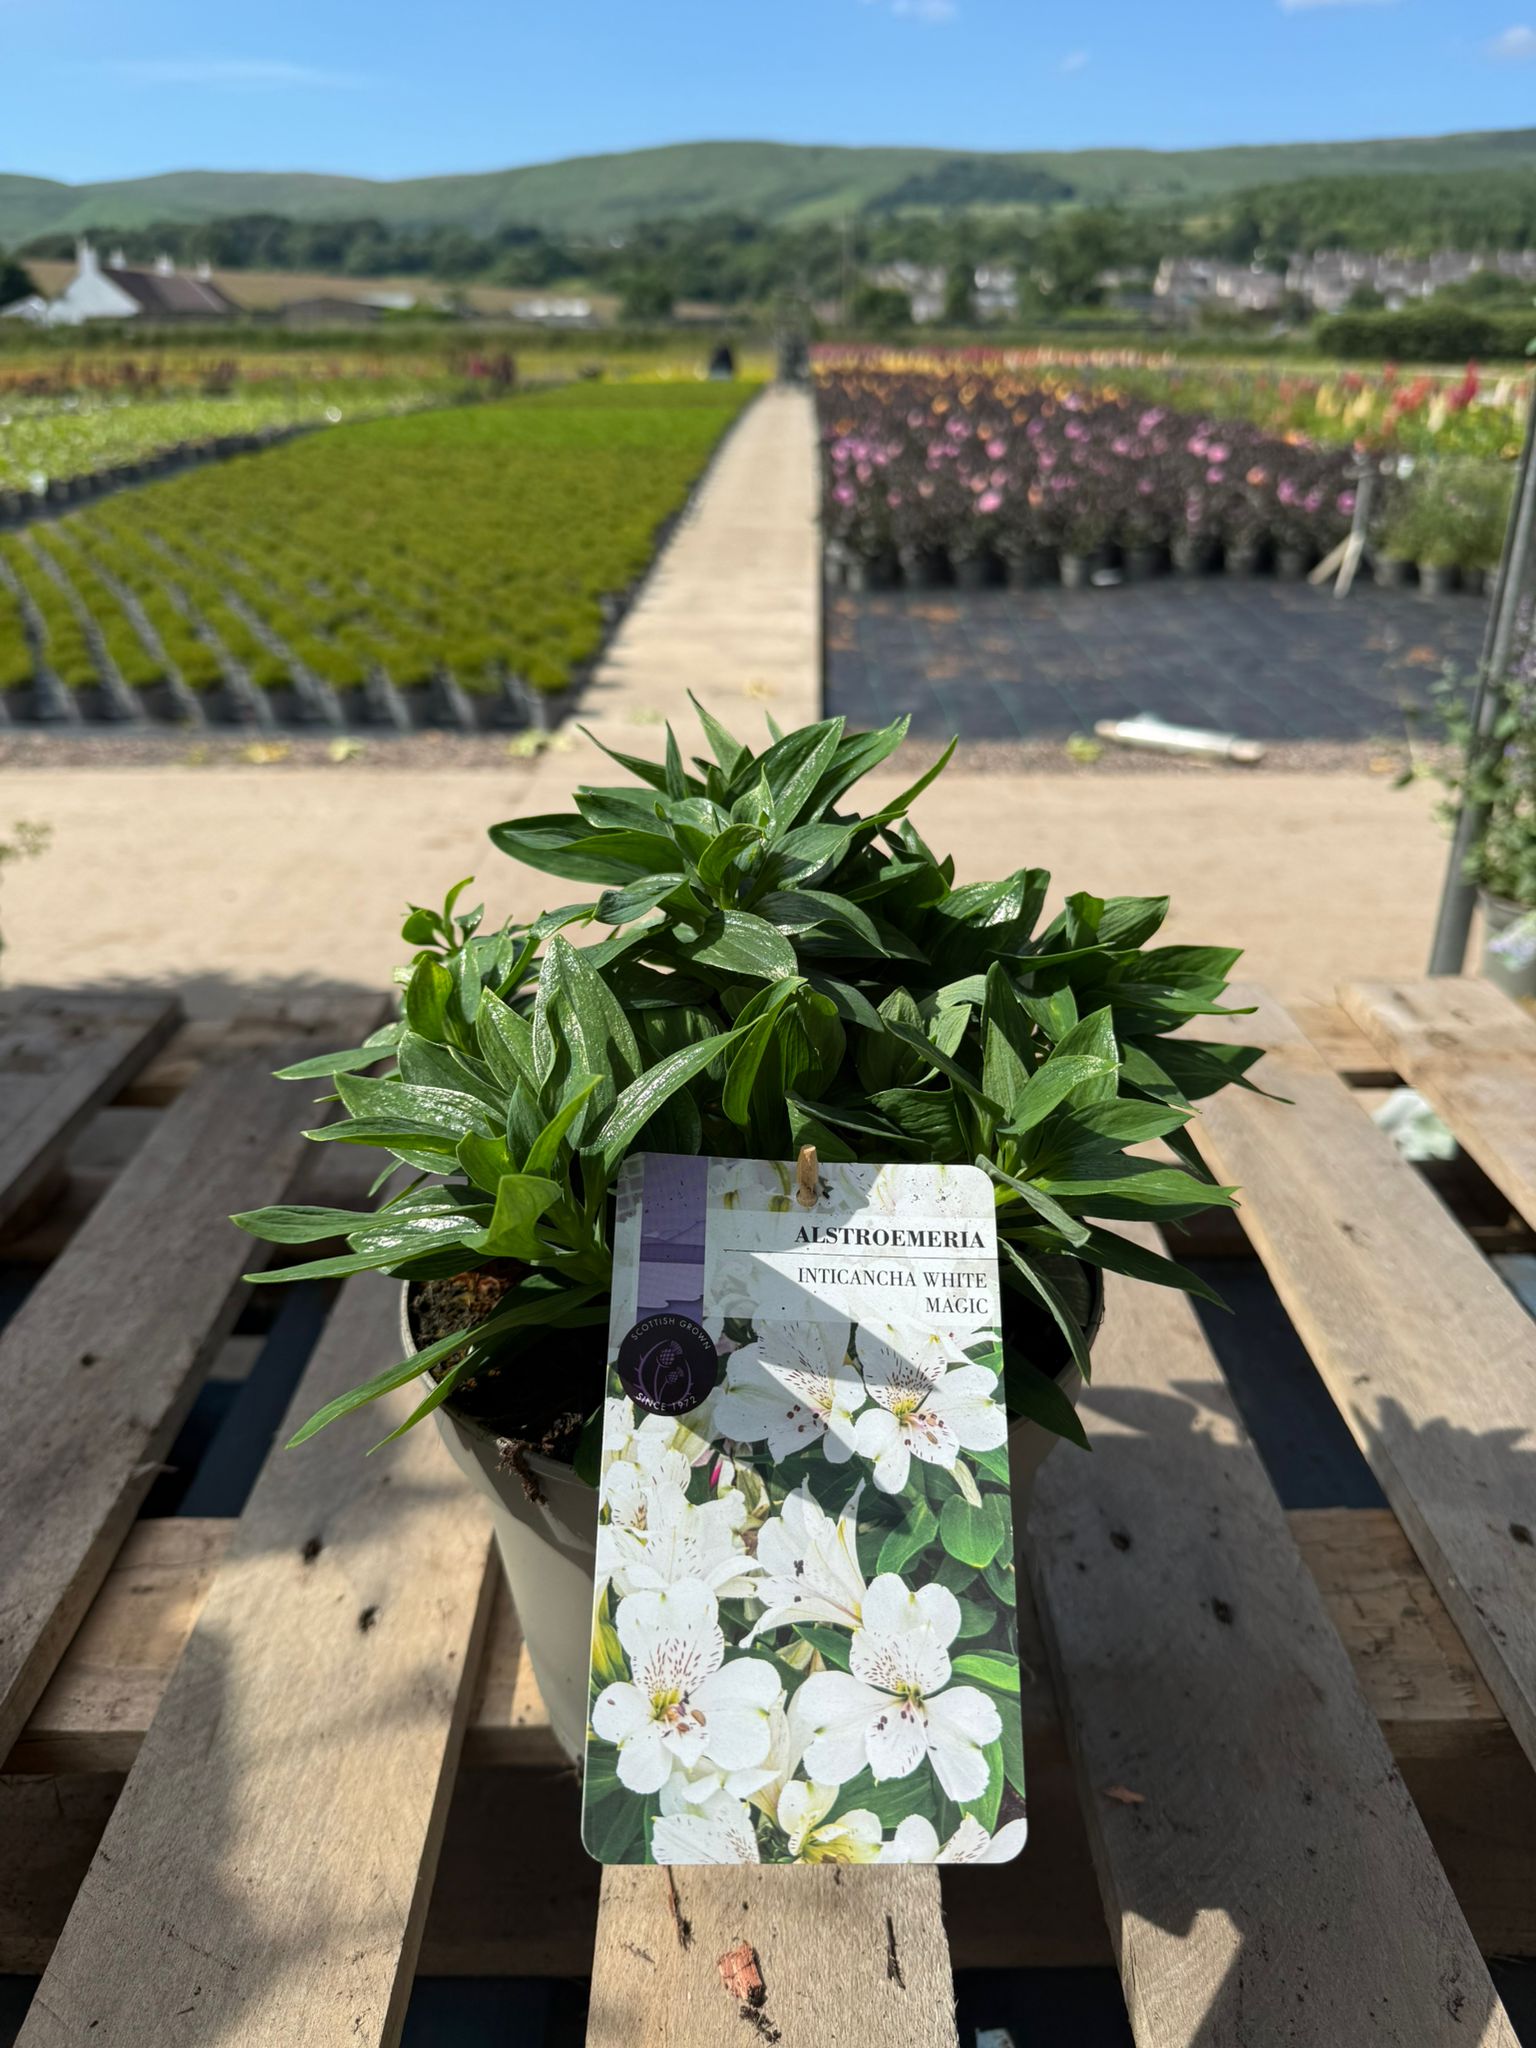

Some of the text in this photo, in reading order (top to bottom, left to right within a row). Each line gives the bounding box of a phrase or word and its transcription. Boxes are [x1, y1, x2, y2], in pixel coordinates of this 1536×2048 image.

[794, 1225, 986, 1249] ALSTROEMERIA
[798, 1266, 988, 1289] INTICANCHA WHITE
[925, 1296, 989, 1315] MAGIC
[630, 1317, 712, 1350] SCOTTISH GROWN
[635, 1392, 698, 1412] SINCE 1972
